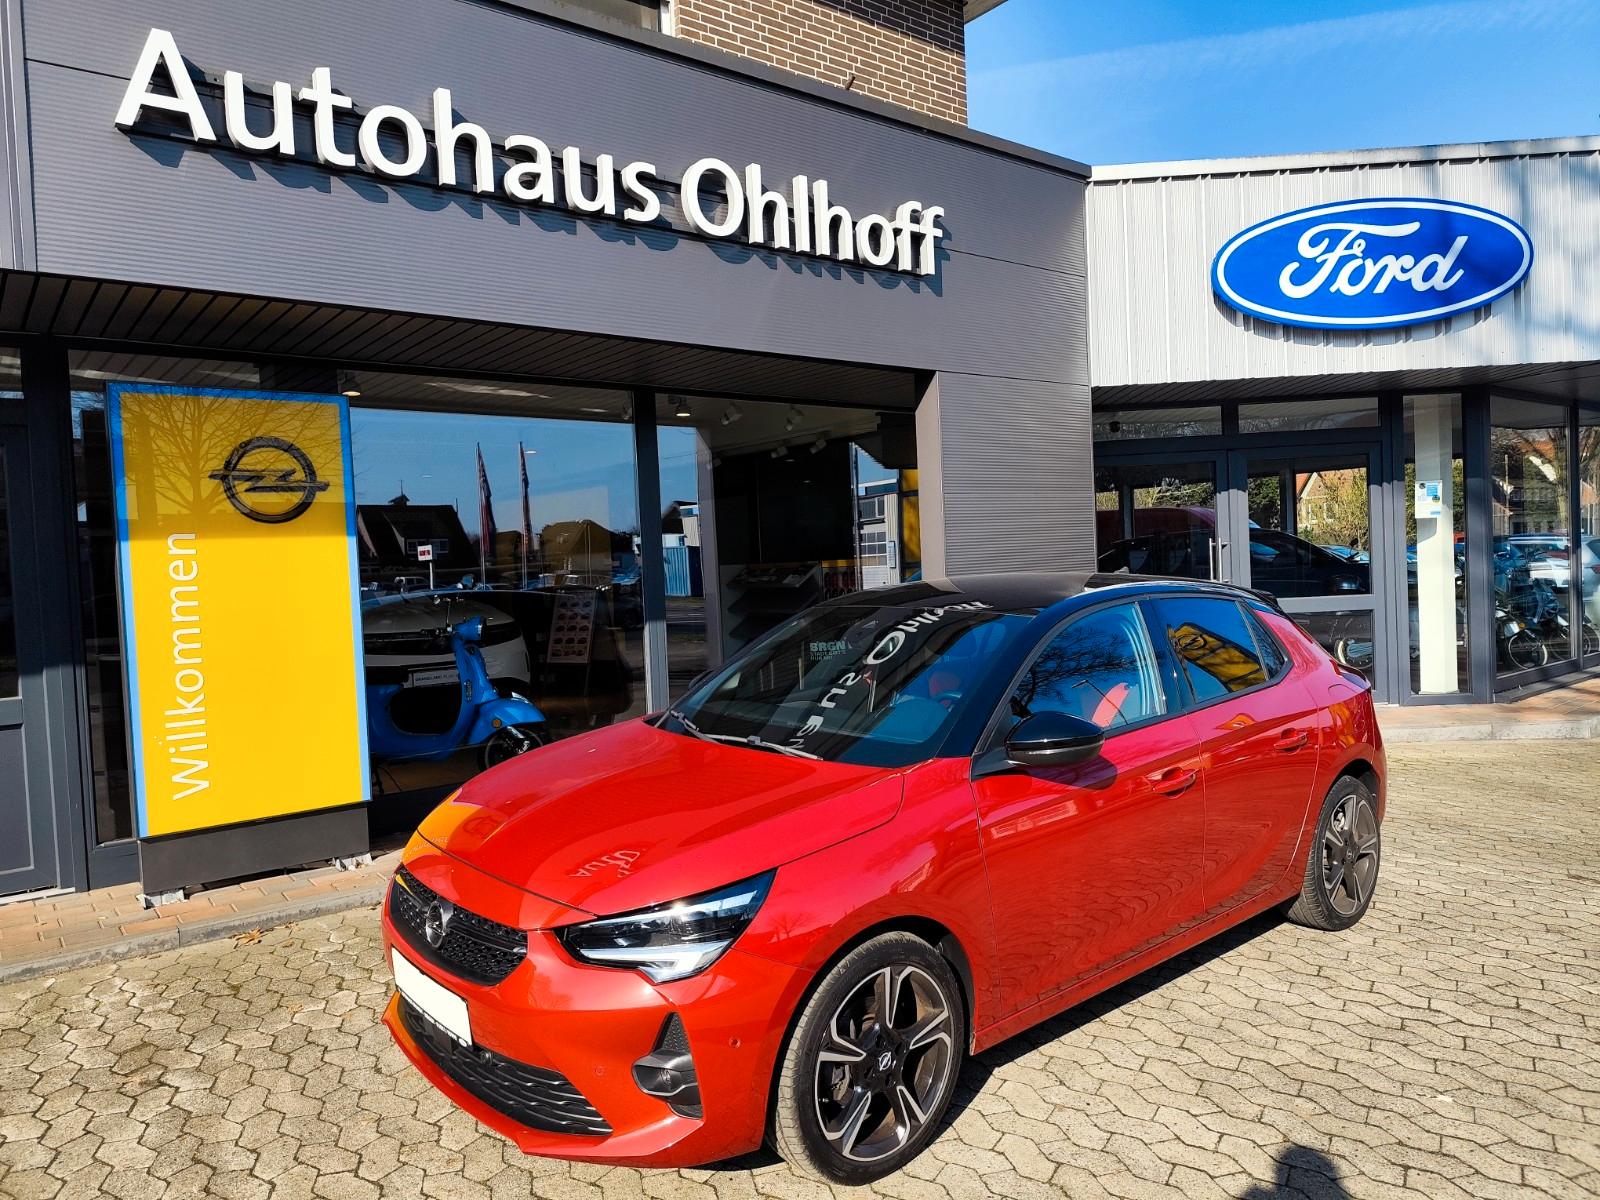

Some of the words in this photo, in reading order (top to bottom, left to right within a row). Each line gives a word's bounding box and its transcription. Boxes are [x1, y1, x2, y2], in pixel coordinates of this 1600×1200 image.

[114, 28, 661, 222] Autohaus
[681, 158, 945, 277] Ohlhoff
[1278, 221, 1468, 299] Ford
[164, 532, 210, 801] Willkommen
